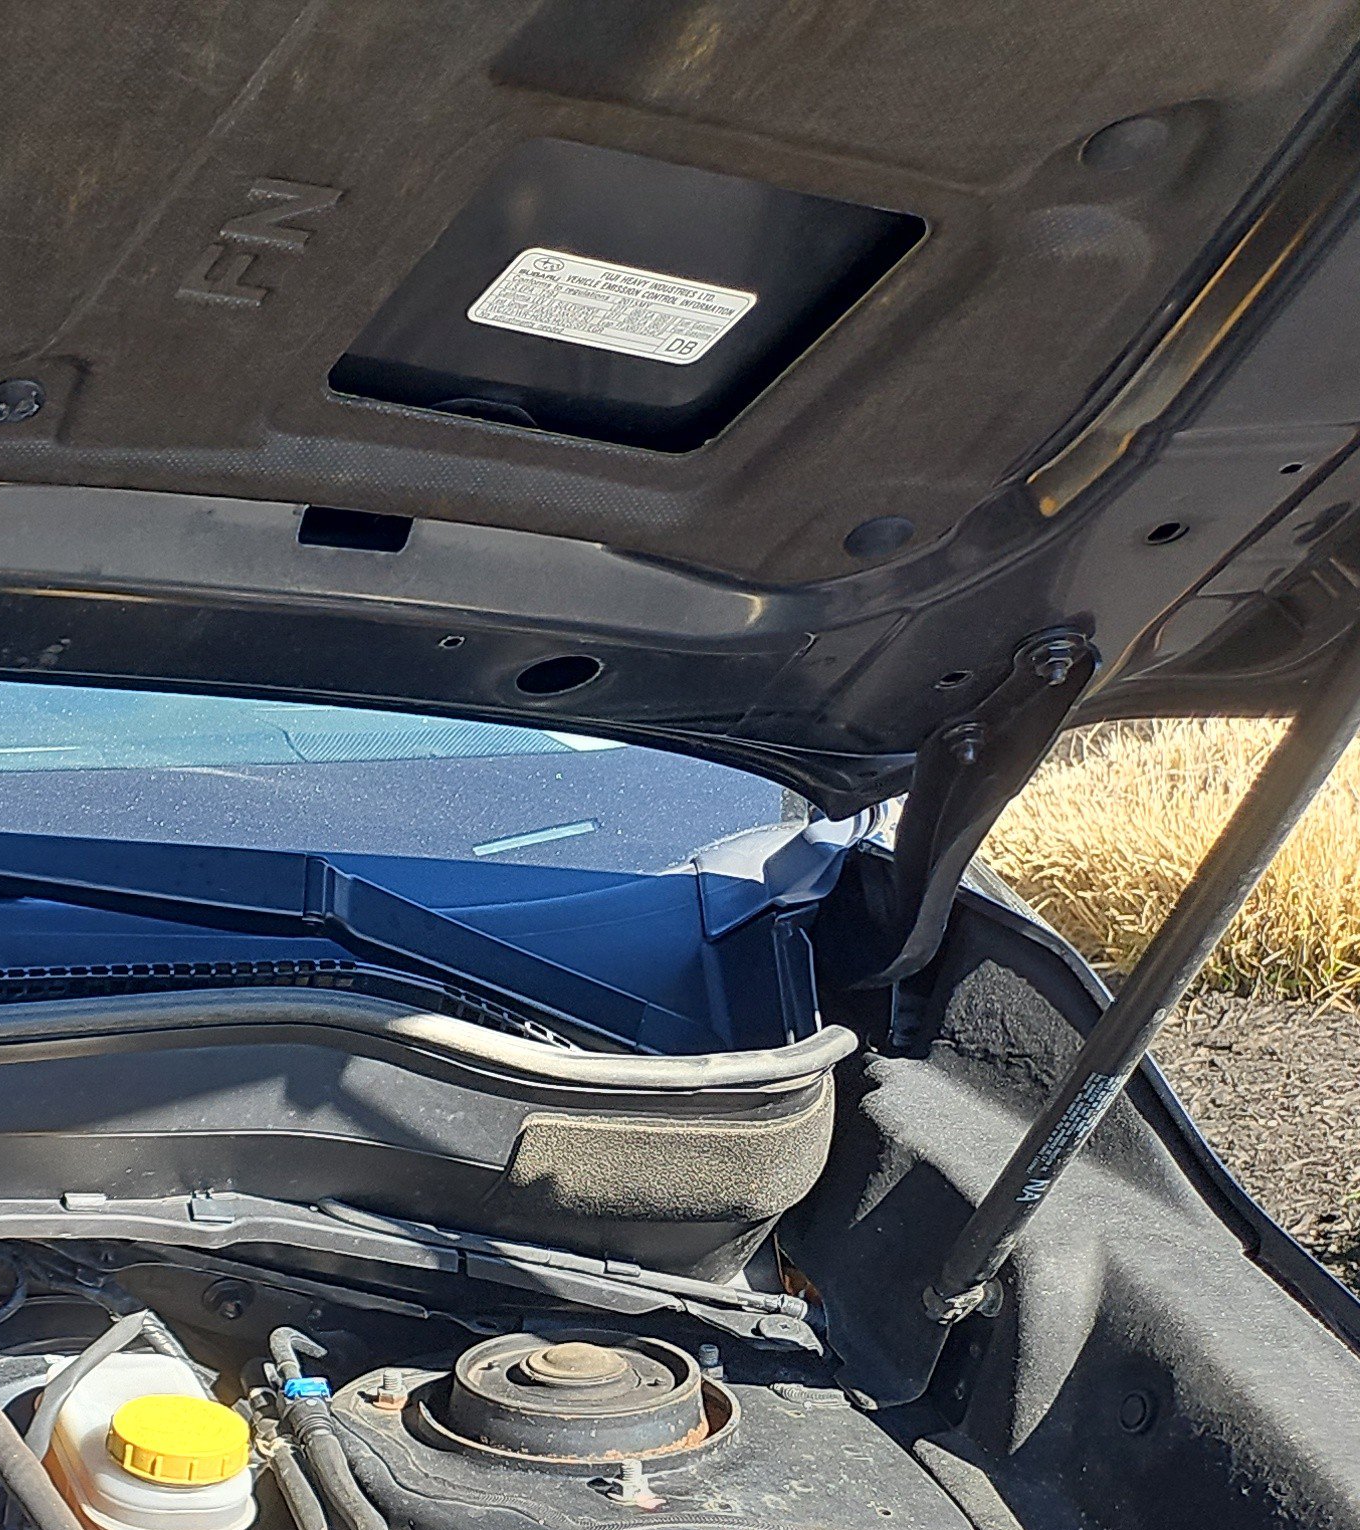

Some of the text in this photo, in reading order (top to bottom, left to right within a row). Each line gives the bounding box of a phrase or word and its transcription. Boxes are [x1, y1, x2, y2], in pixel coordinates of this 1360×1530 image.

[566, 275, 735, 317] VEHICLE EMISSION CONTROL INFORMATION
[600, 271, 621, 282] FUJI
[619, 276, 649, 288] HEAVY
[649, 282, 698, 299] INDUSTRIES
[665, 338, 698, 355] DB
